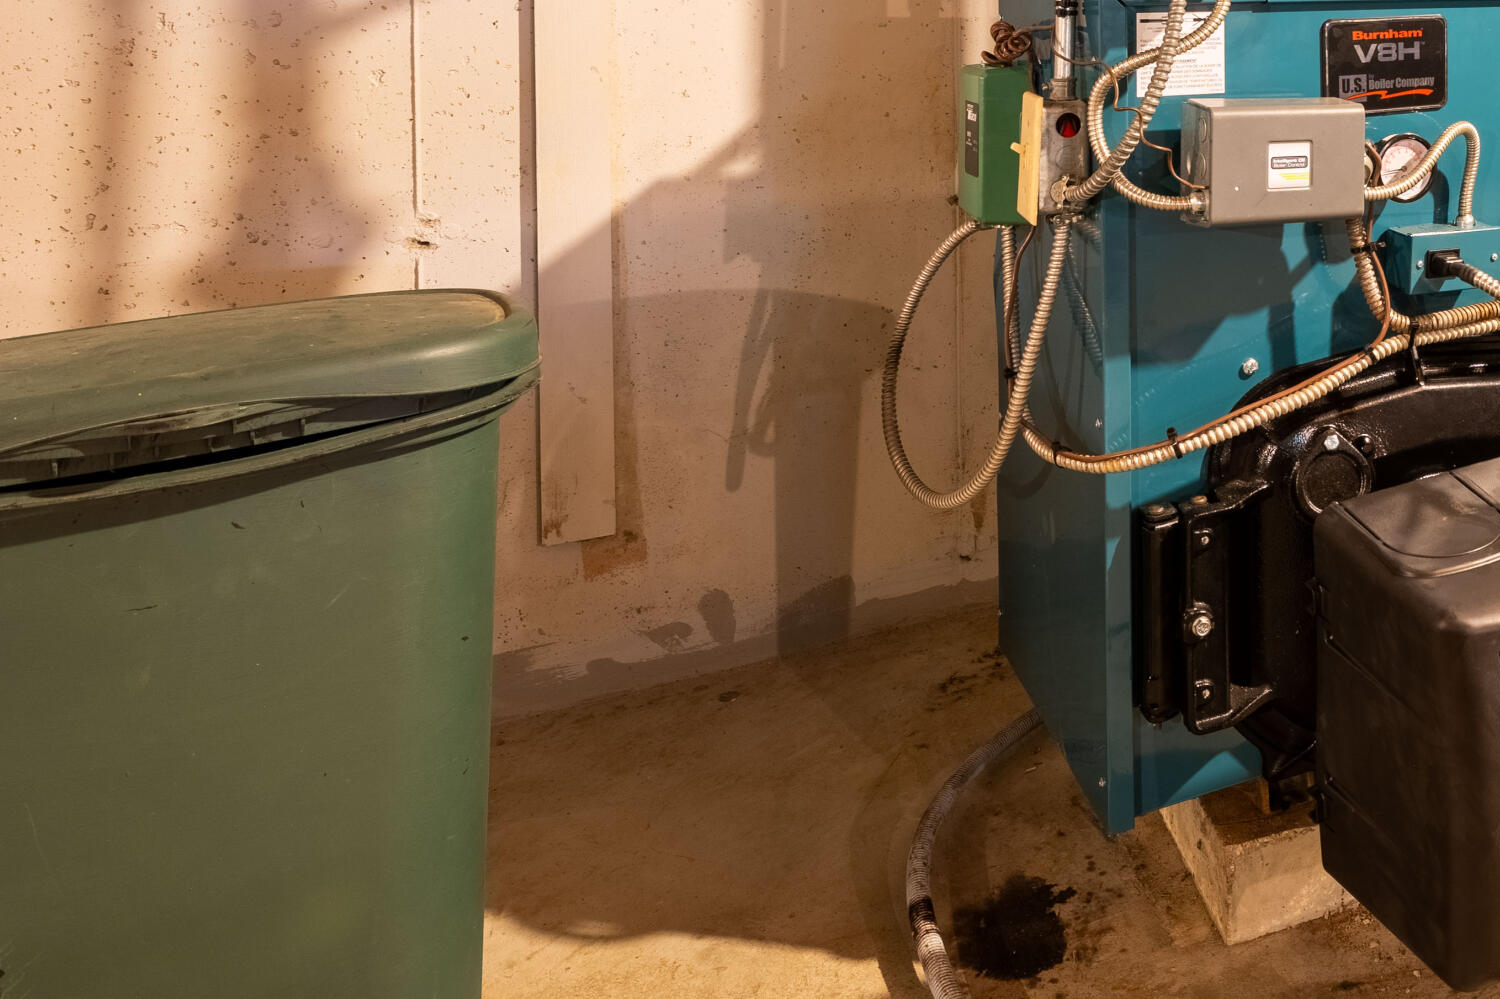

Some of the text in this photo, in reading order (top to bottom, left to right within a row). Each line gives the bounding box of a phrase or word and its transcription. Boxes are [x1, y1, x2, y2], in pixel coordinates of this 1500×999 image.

[1352, 29, 1422, 41] Burnham
[1353, 41, 1421, 63] V8H
[1341, 76, 1435, 93] U.S. Boiler Company
